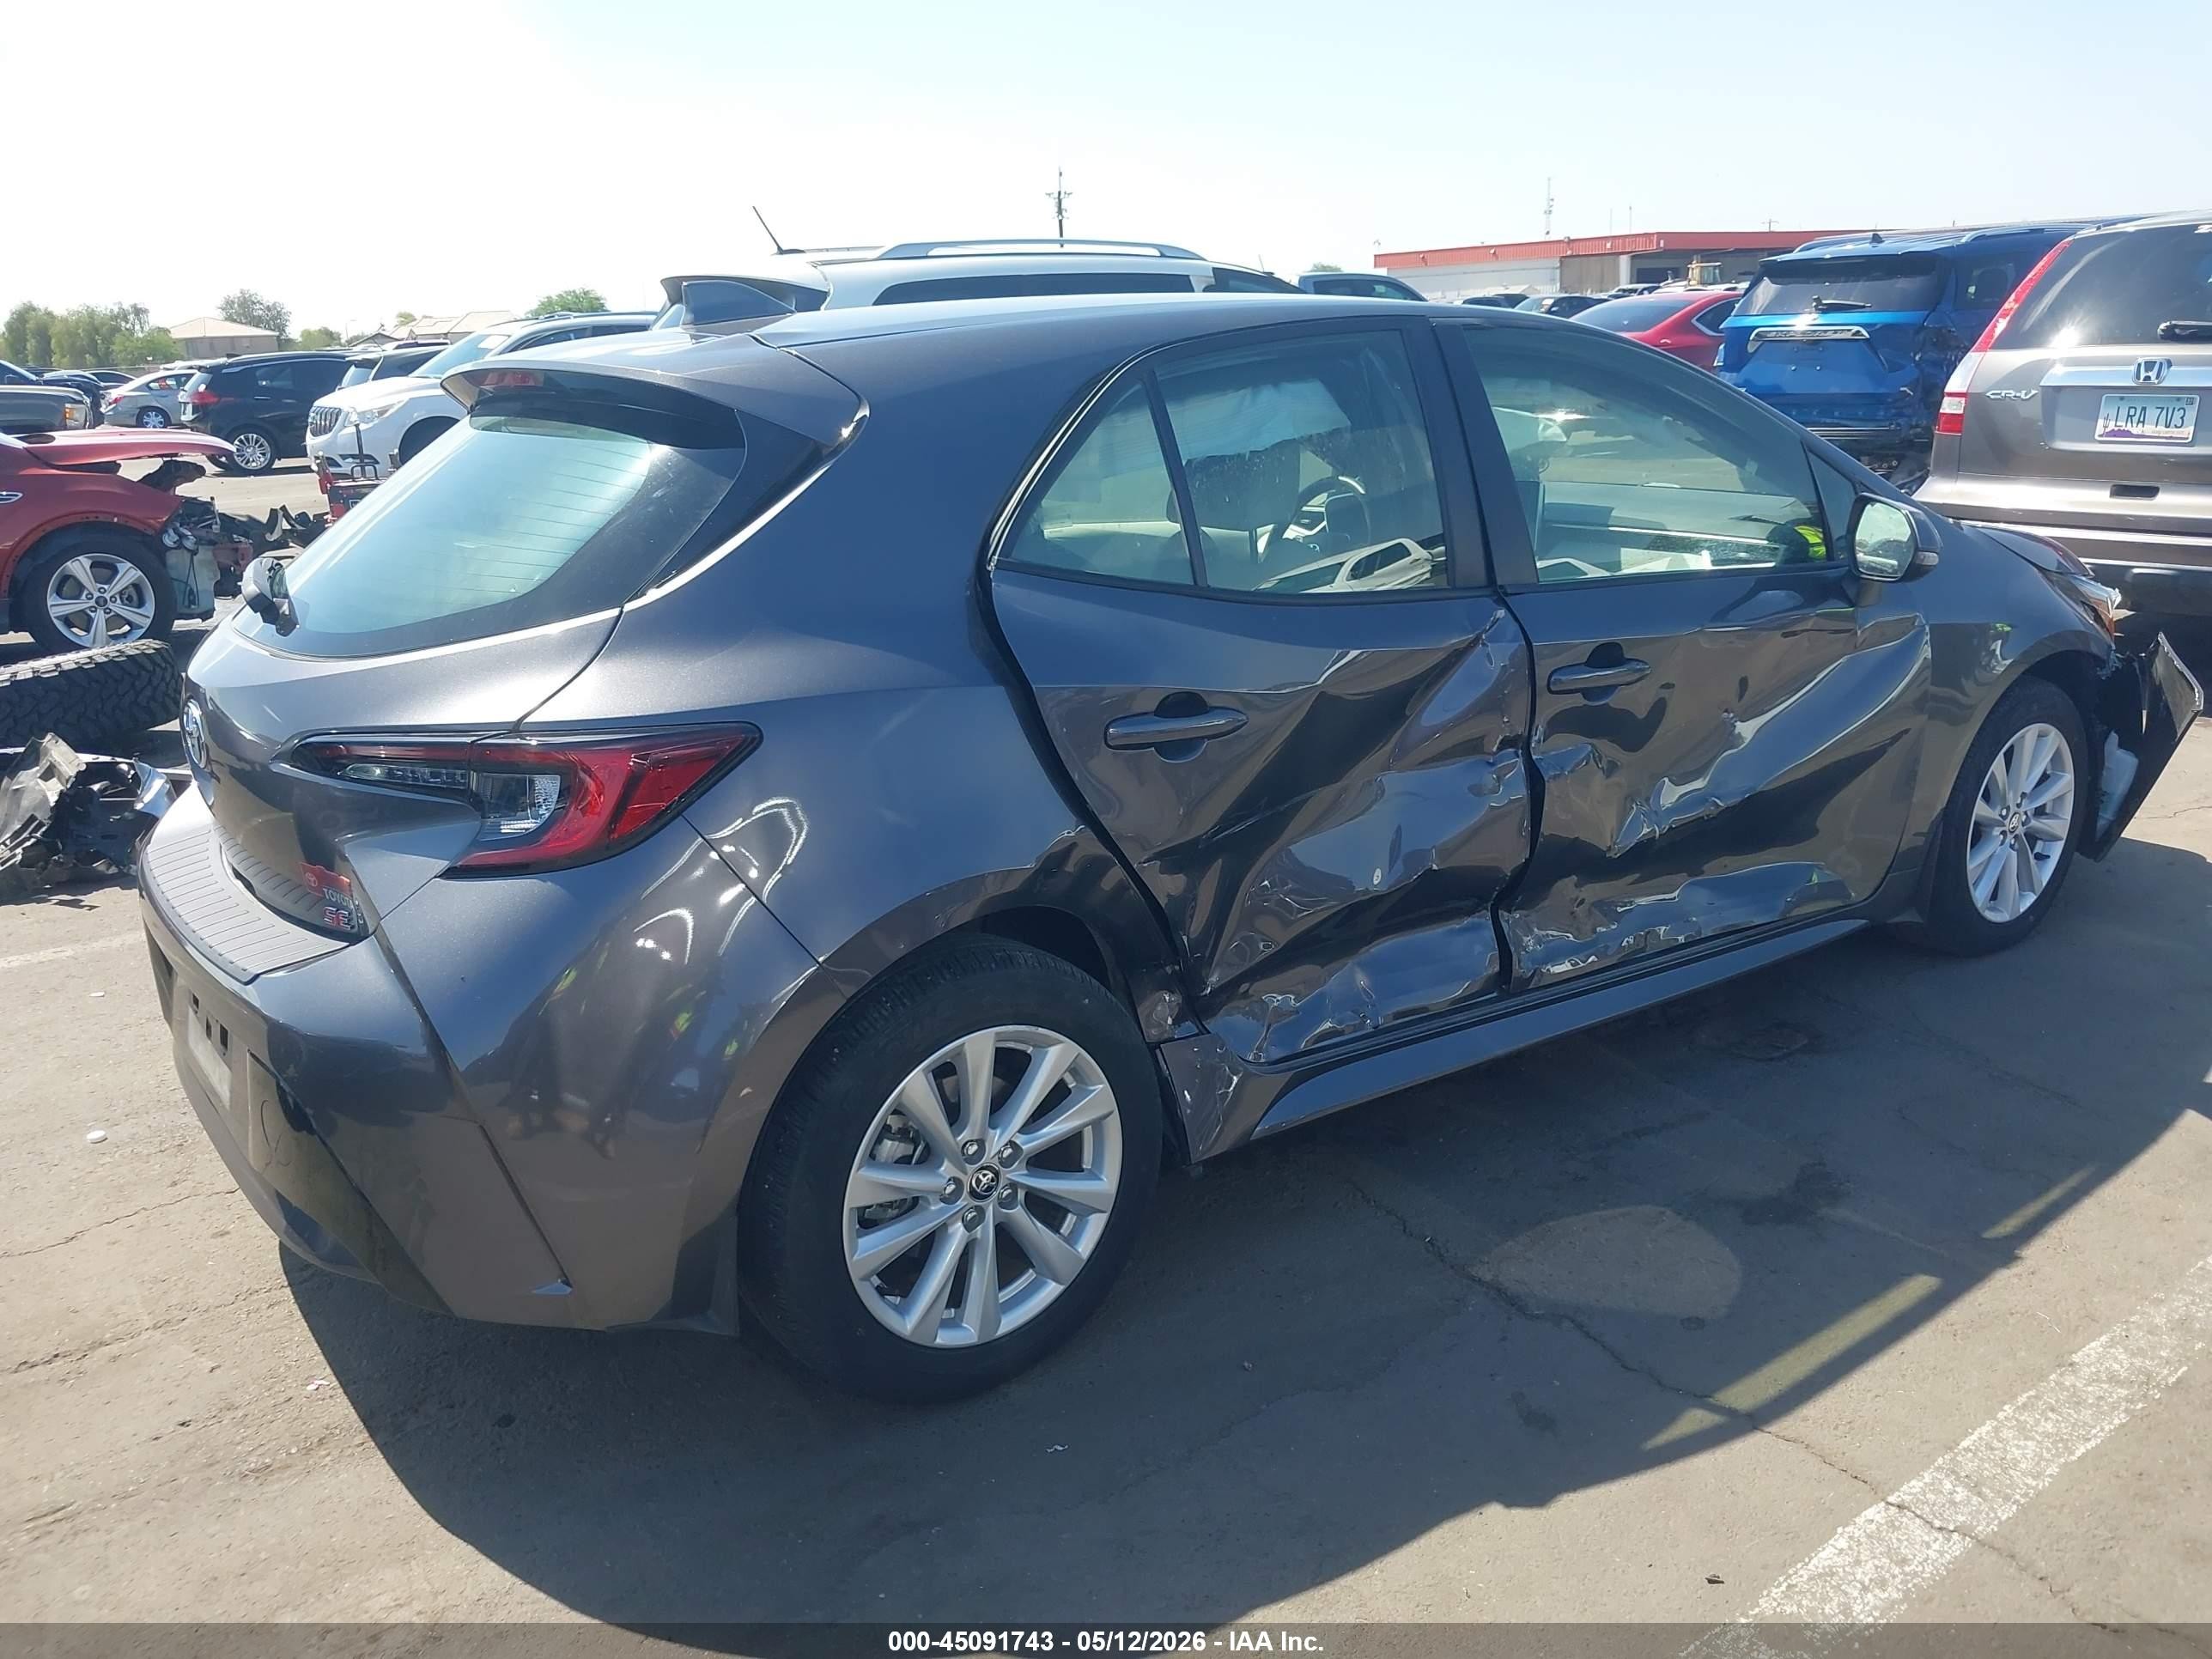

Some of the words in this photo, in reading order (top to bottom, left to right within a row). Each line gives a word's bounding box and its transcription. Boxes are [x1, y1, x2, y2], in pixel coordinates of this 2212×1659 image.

[1985, 389, 2039, 400] CR-V
[2114, 405, 2148, 428] LRA
[2154, 405, 2186, 429] 7V3
